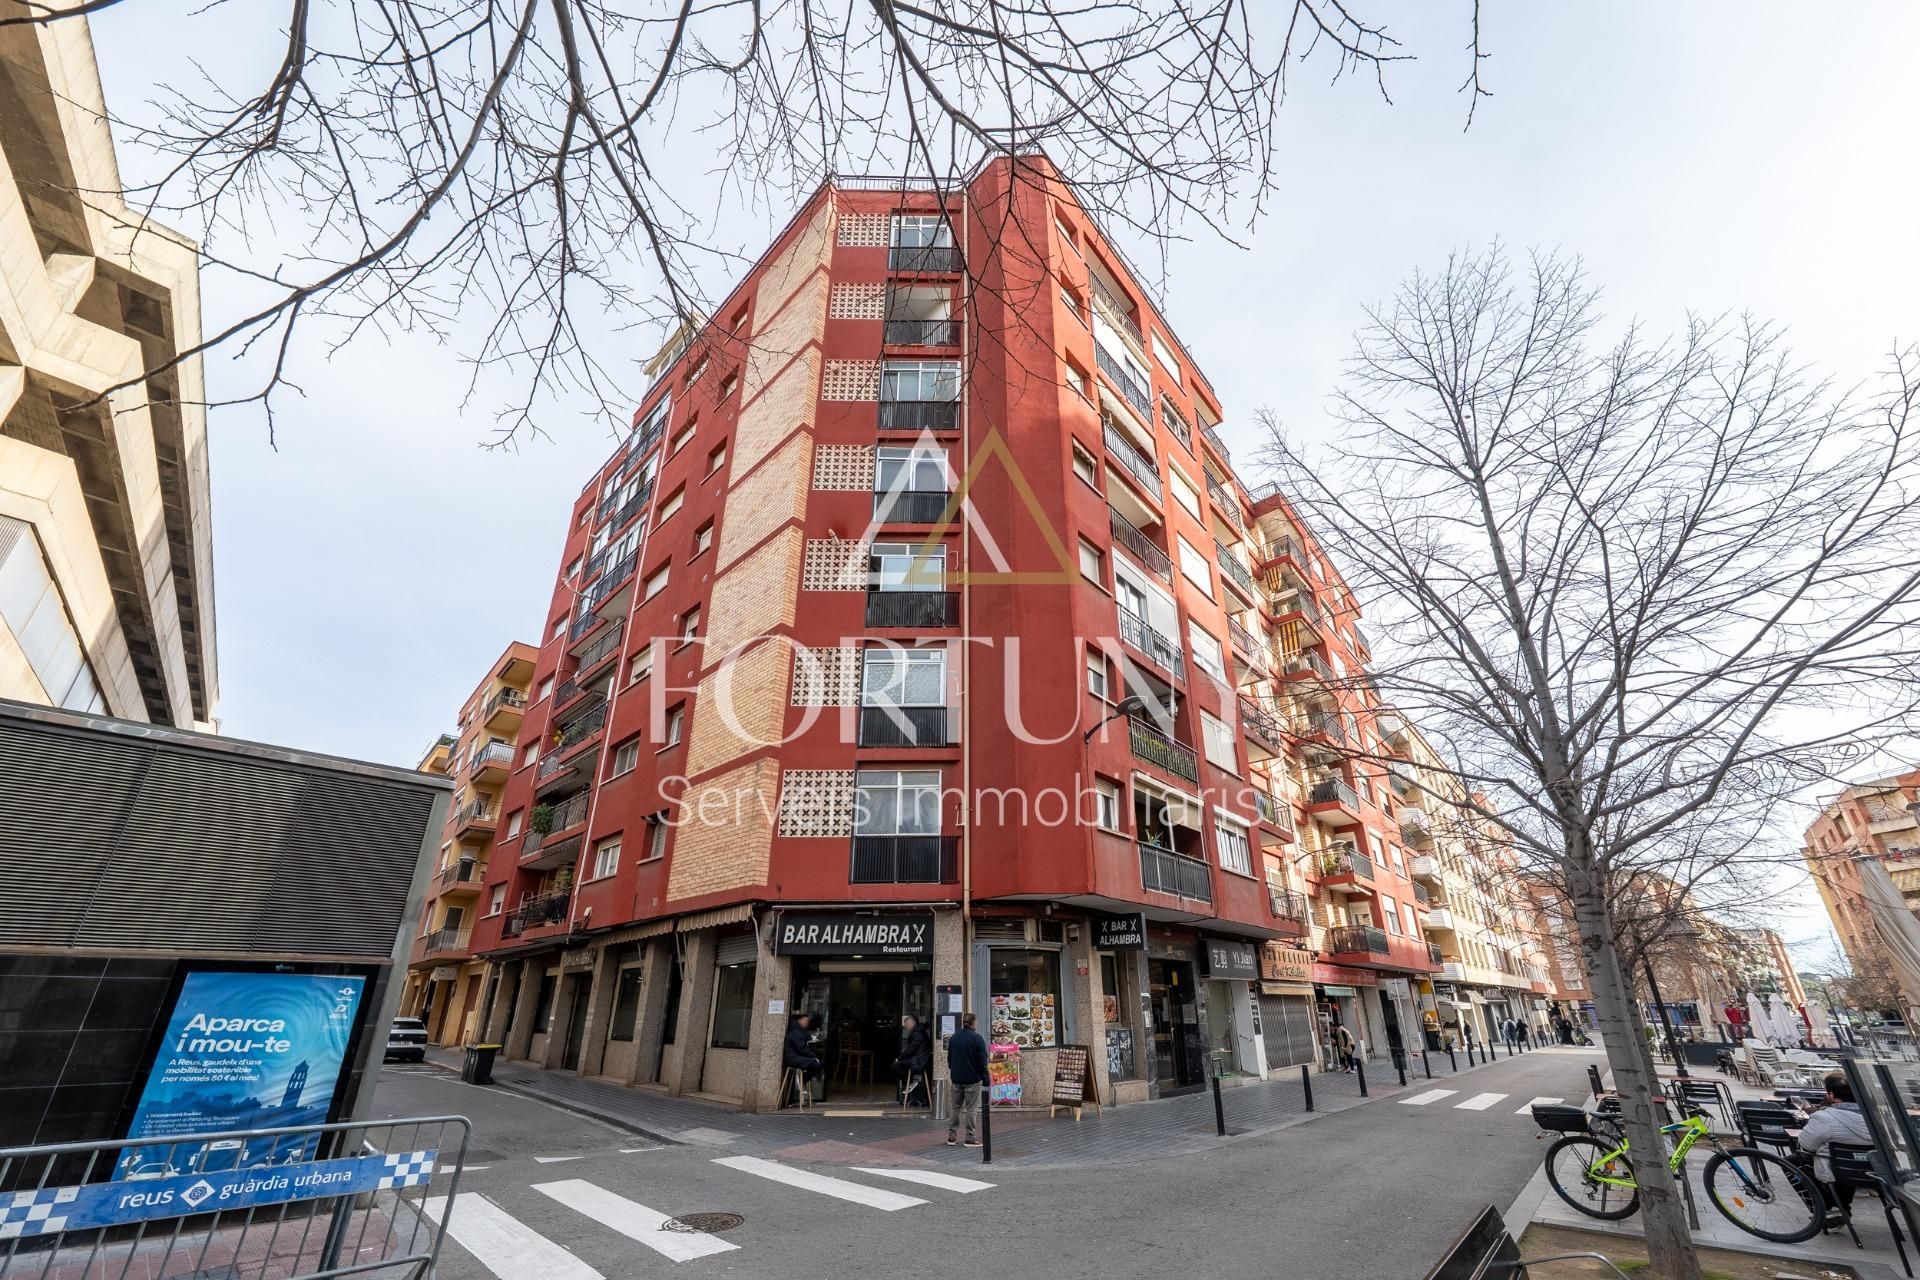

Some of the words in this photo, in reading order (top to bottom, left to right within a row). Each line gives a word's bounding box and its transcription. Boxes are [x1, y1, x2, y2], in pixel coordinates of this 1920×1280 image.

[1111, 920, 1127, 931] BAR
[783, 924, 819, 944] BAR
[820, 924, 910, 944] ALHAMBRA
[1100, 934, 1141, 945] ALHAMBRA
[883, 945, 923, 953] Restaurant
[184, 1013, 285, 1036] Aparca
[176, 1033, 188, 1053] i
[188, 1036, 291, 1053] mou-te
[165, 1066, 207, 1074] mobilitat
[207, 1066, 252, 1074] sostenible
[161, 1075, 178, 1084] per
[179, 1074, 210, 1082] només
[119, 1188, 175, 1209] reus
[219, 1175, 289, 1200] guàrdia
[294, 1170, 353, 1187] urbana
